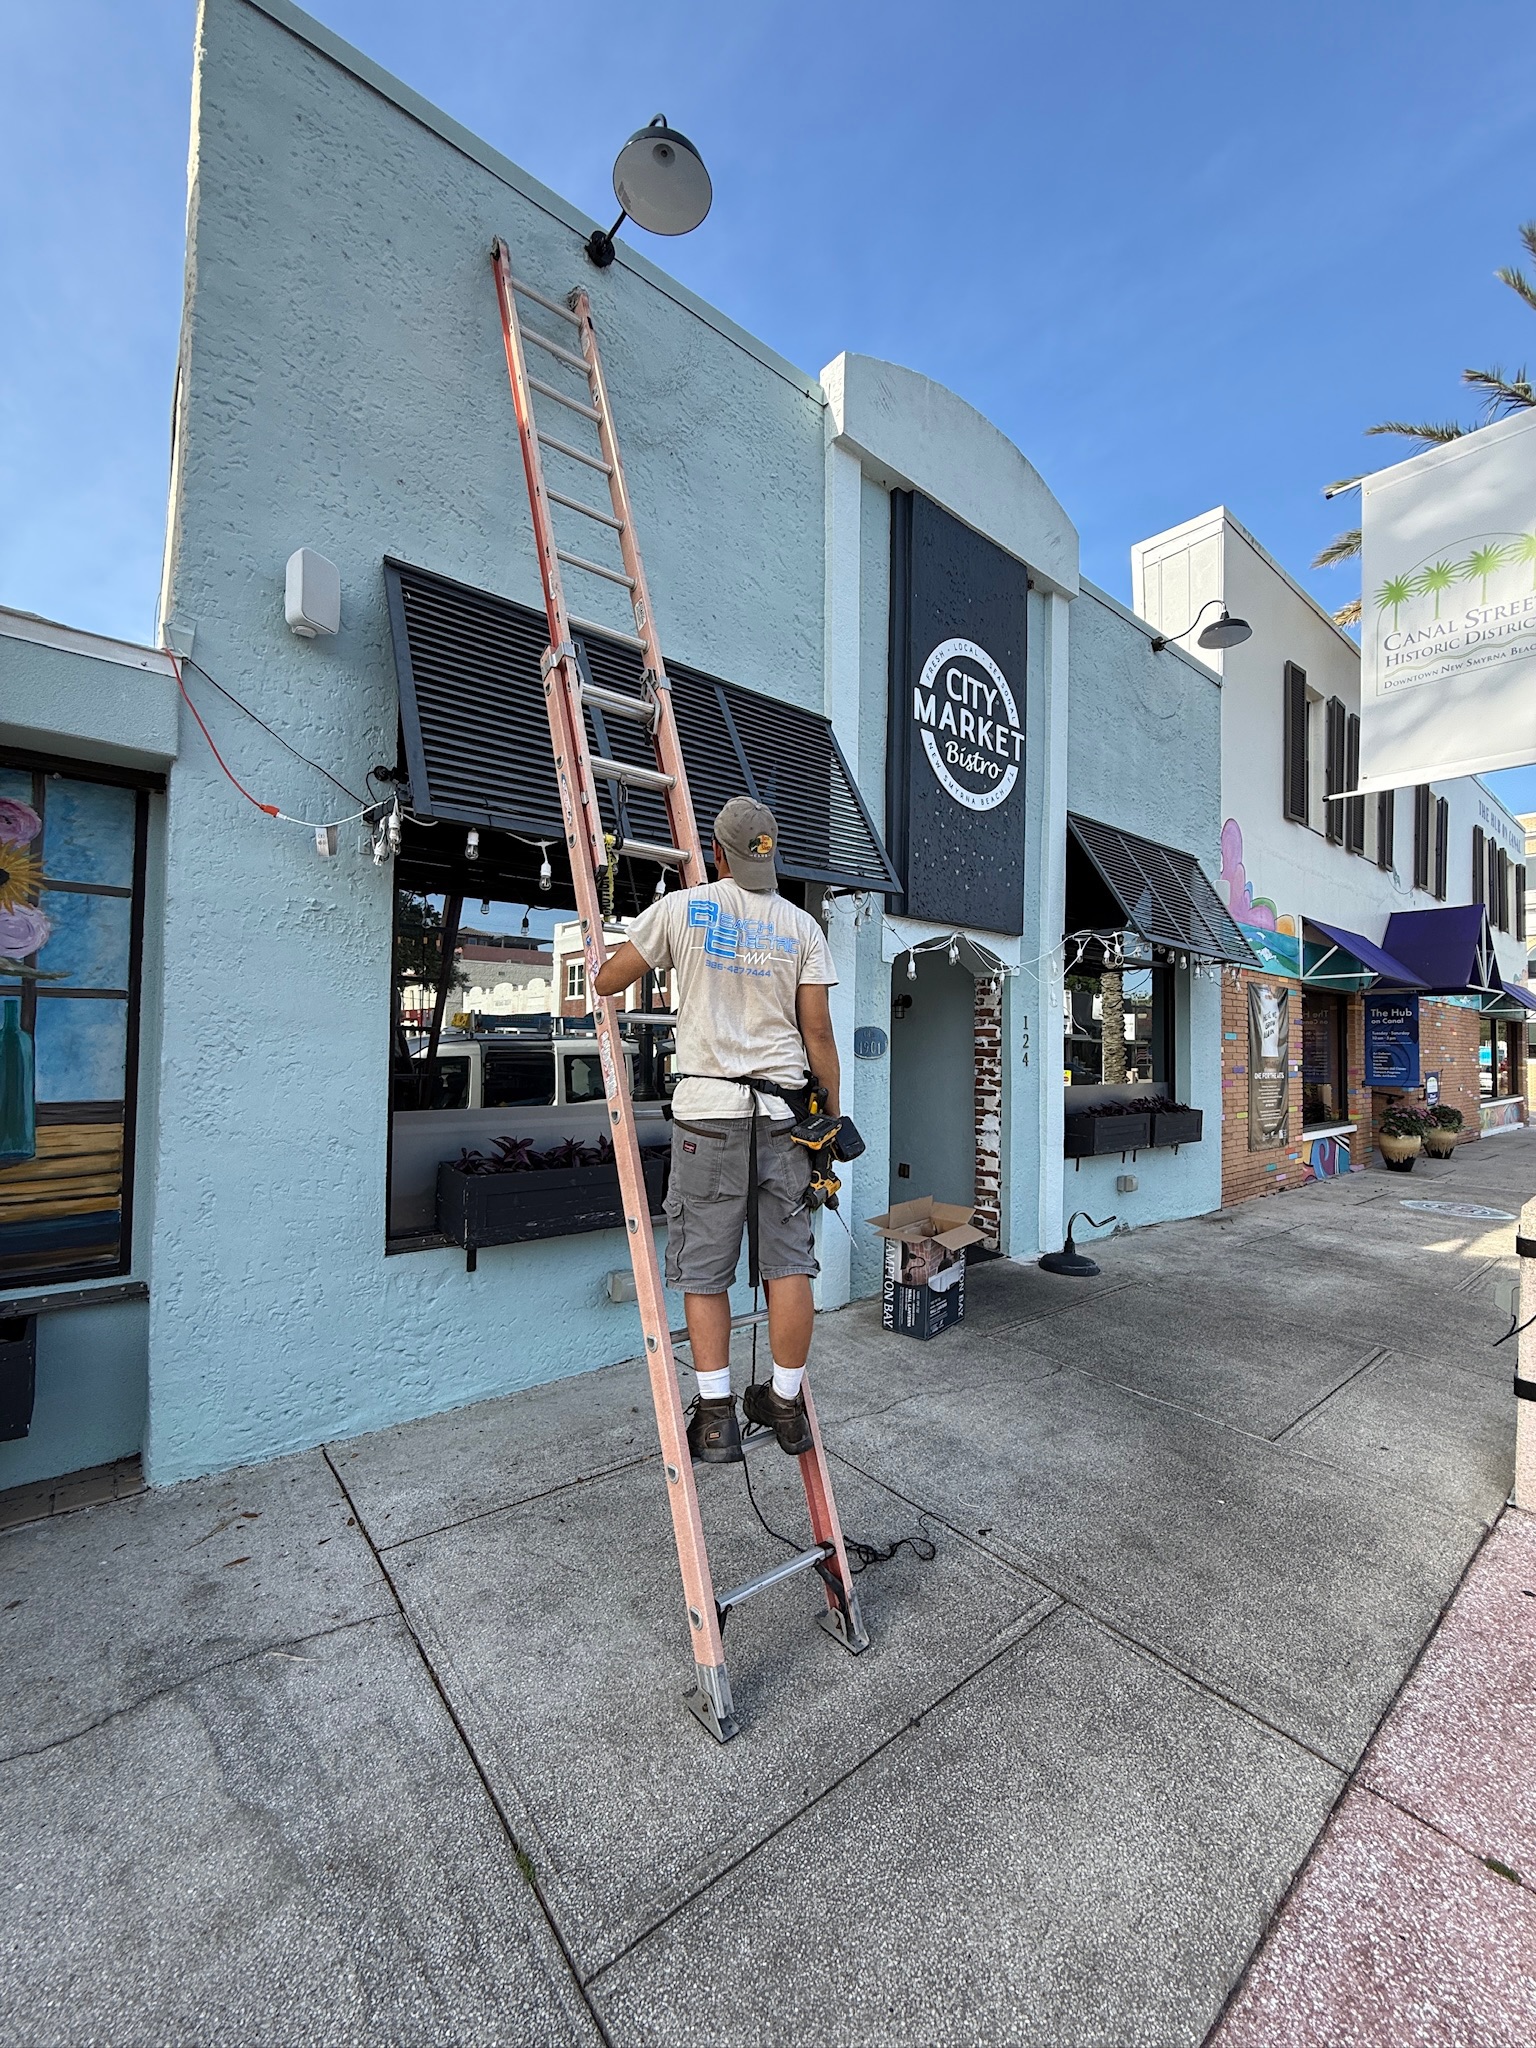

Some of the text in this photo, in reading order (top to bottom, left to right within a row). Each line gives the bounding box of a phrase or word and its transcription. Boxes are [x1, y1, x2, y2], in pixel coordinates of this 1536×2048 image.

[1384, 596, 1536, 651] CANAL STREE
[1386, 616, 1536, 668] HISTORIC DISTRIC
[926, 643, 1017, 721] FRESH LOCAL SEASONAL
[1384, 643, 1536, 689] DOWNTOWN NEW SMYRNA BEAC
[946, 667, 998, 717] CITY
[914, 687, 1025, 762] MARKET
[928, 742, 942, 768] NEW
[943, 774, 976, 805] SMYRNA
[945, 740, 1003, 780] Bistro
[1479, 800, 1489, 823] THE
[1370, 1008, 1413, 1017] The Hub
[883, 1303, 894, 1329] BAY
